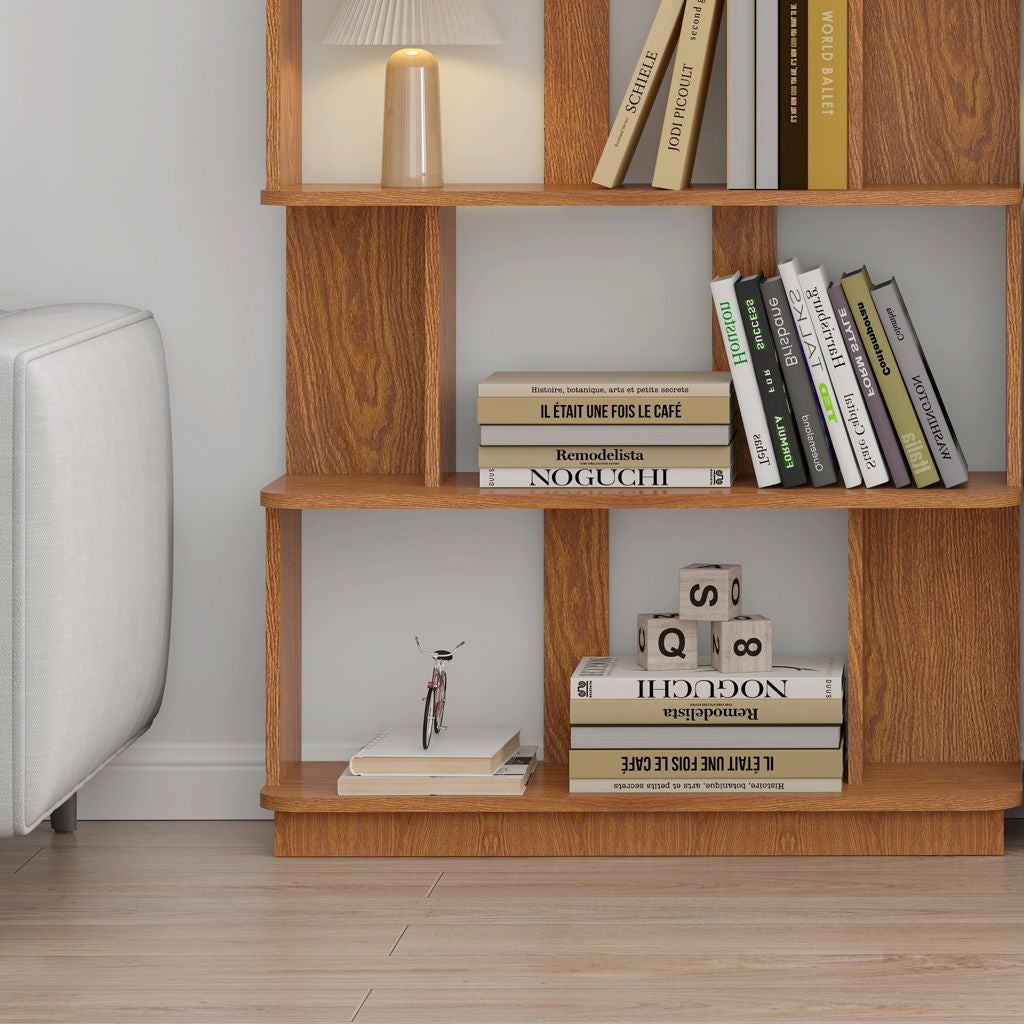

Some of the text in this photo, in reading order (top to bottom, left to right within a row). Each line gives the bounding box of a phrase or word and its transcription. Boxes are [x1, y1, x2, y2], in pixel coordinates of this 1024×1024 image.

[690, 6, 703, 41] second
[821, 10, 834, 116] WORLD BALLET
[625, 50, 659, 114] SCHIELE
[667, 63, 694, 152] JODI PICOULT
[531, 386, 565, 394] Histoire,
[567, 386, 606, 394] botanique,
[636, 386, 659, 394] petits
[540, 401, 682, 418] IL ÉTAIT UNE FOIS LE CAFÉ
[555, 449, 644, 462] Remodelista
[529, 469, 669, 487] NOGUCHI
[658, 628, 686, 659] Q
[733, 637, 762, 657] 8
[637, 679, 788, 698] NOGUCHI
[664, 708, 758, 721] Remodelista
